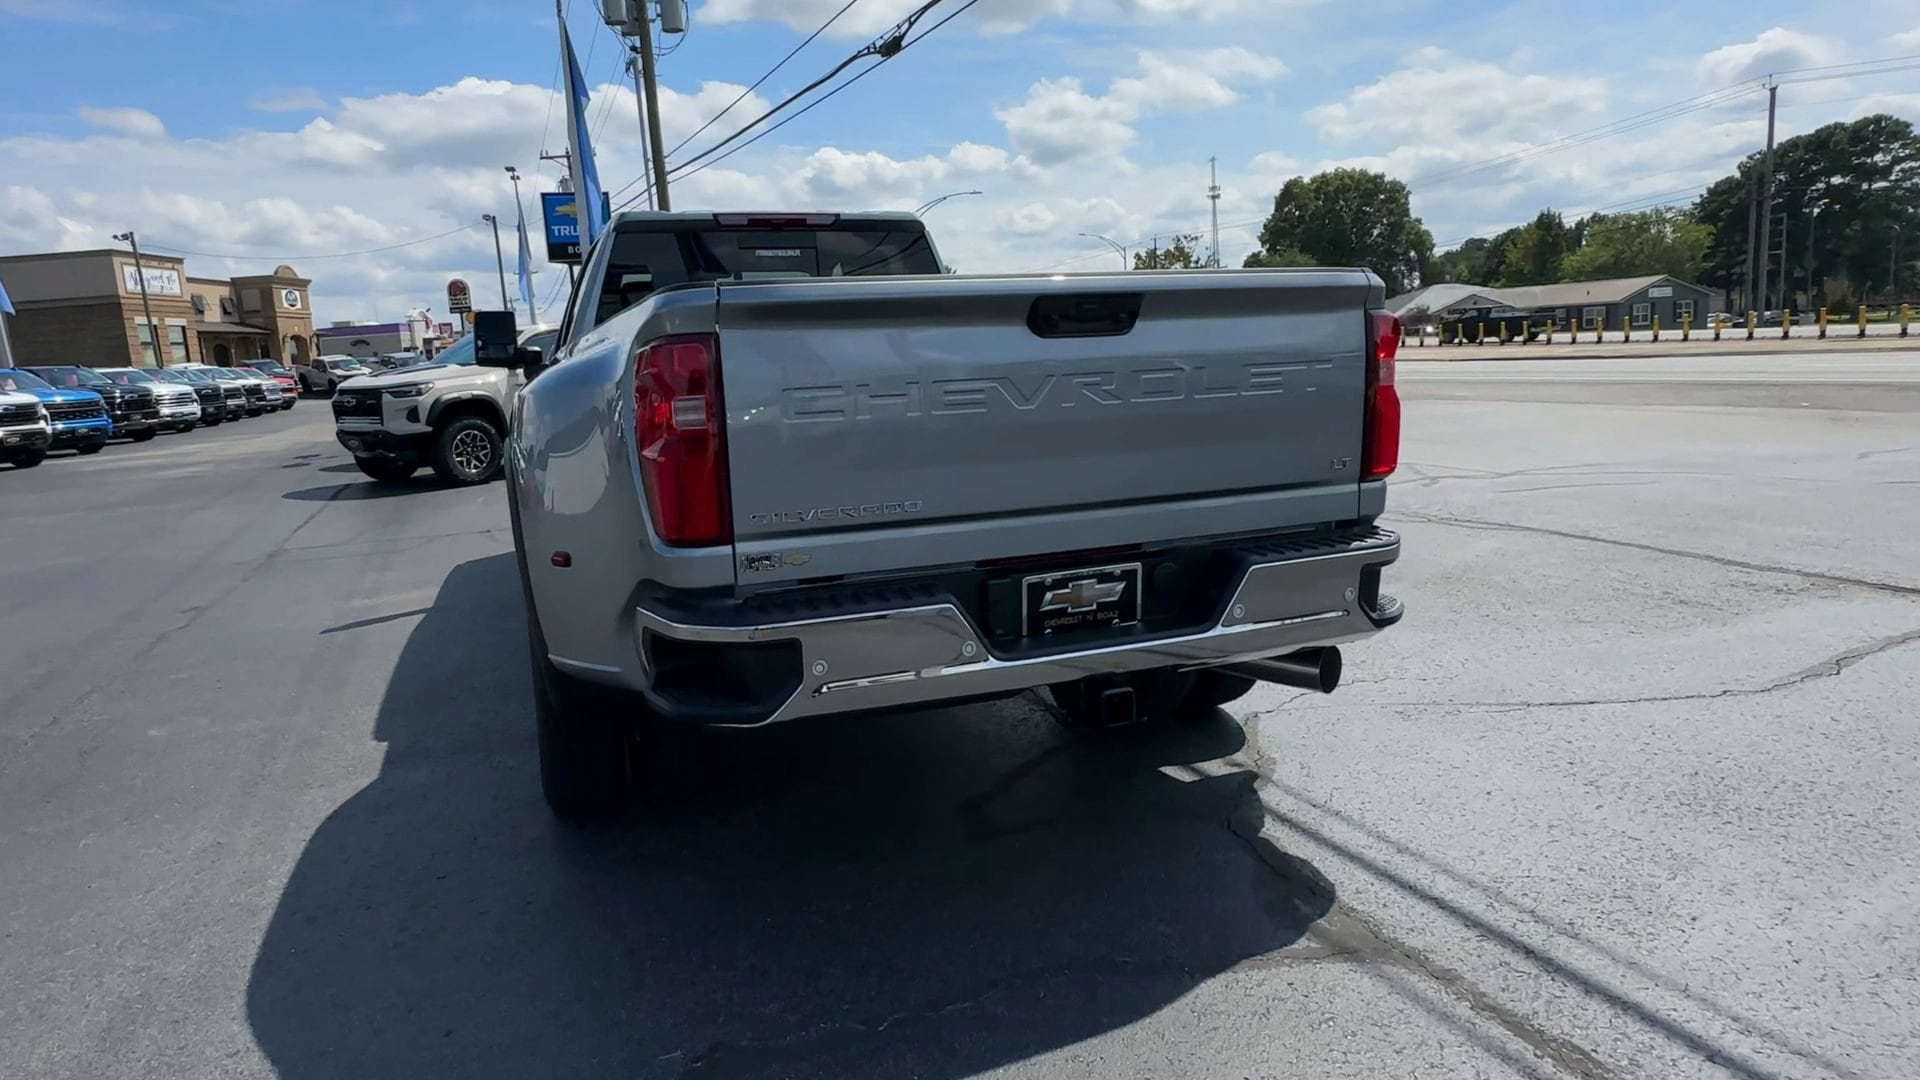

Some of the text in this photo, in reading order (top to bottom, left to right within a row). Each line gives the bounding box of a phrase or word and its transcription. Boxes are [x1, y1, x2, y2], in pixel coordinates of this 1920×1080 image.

[551, 225, 580, 236] TRU
[783, 359, 1333, 423] CHEVROLET
[1330, 457, 1353, 470] LT
[750, 500, 922, 524] SILVERADO
